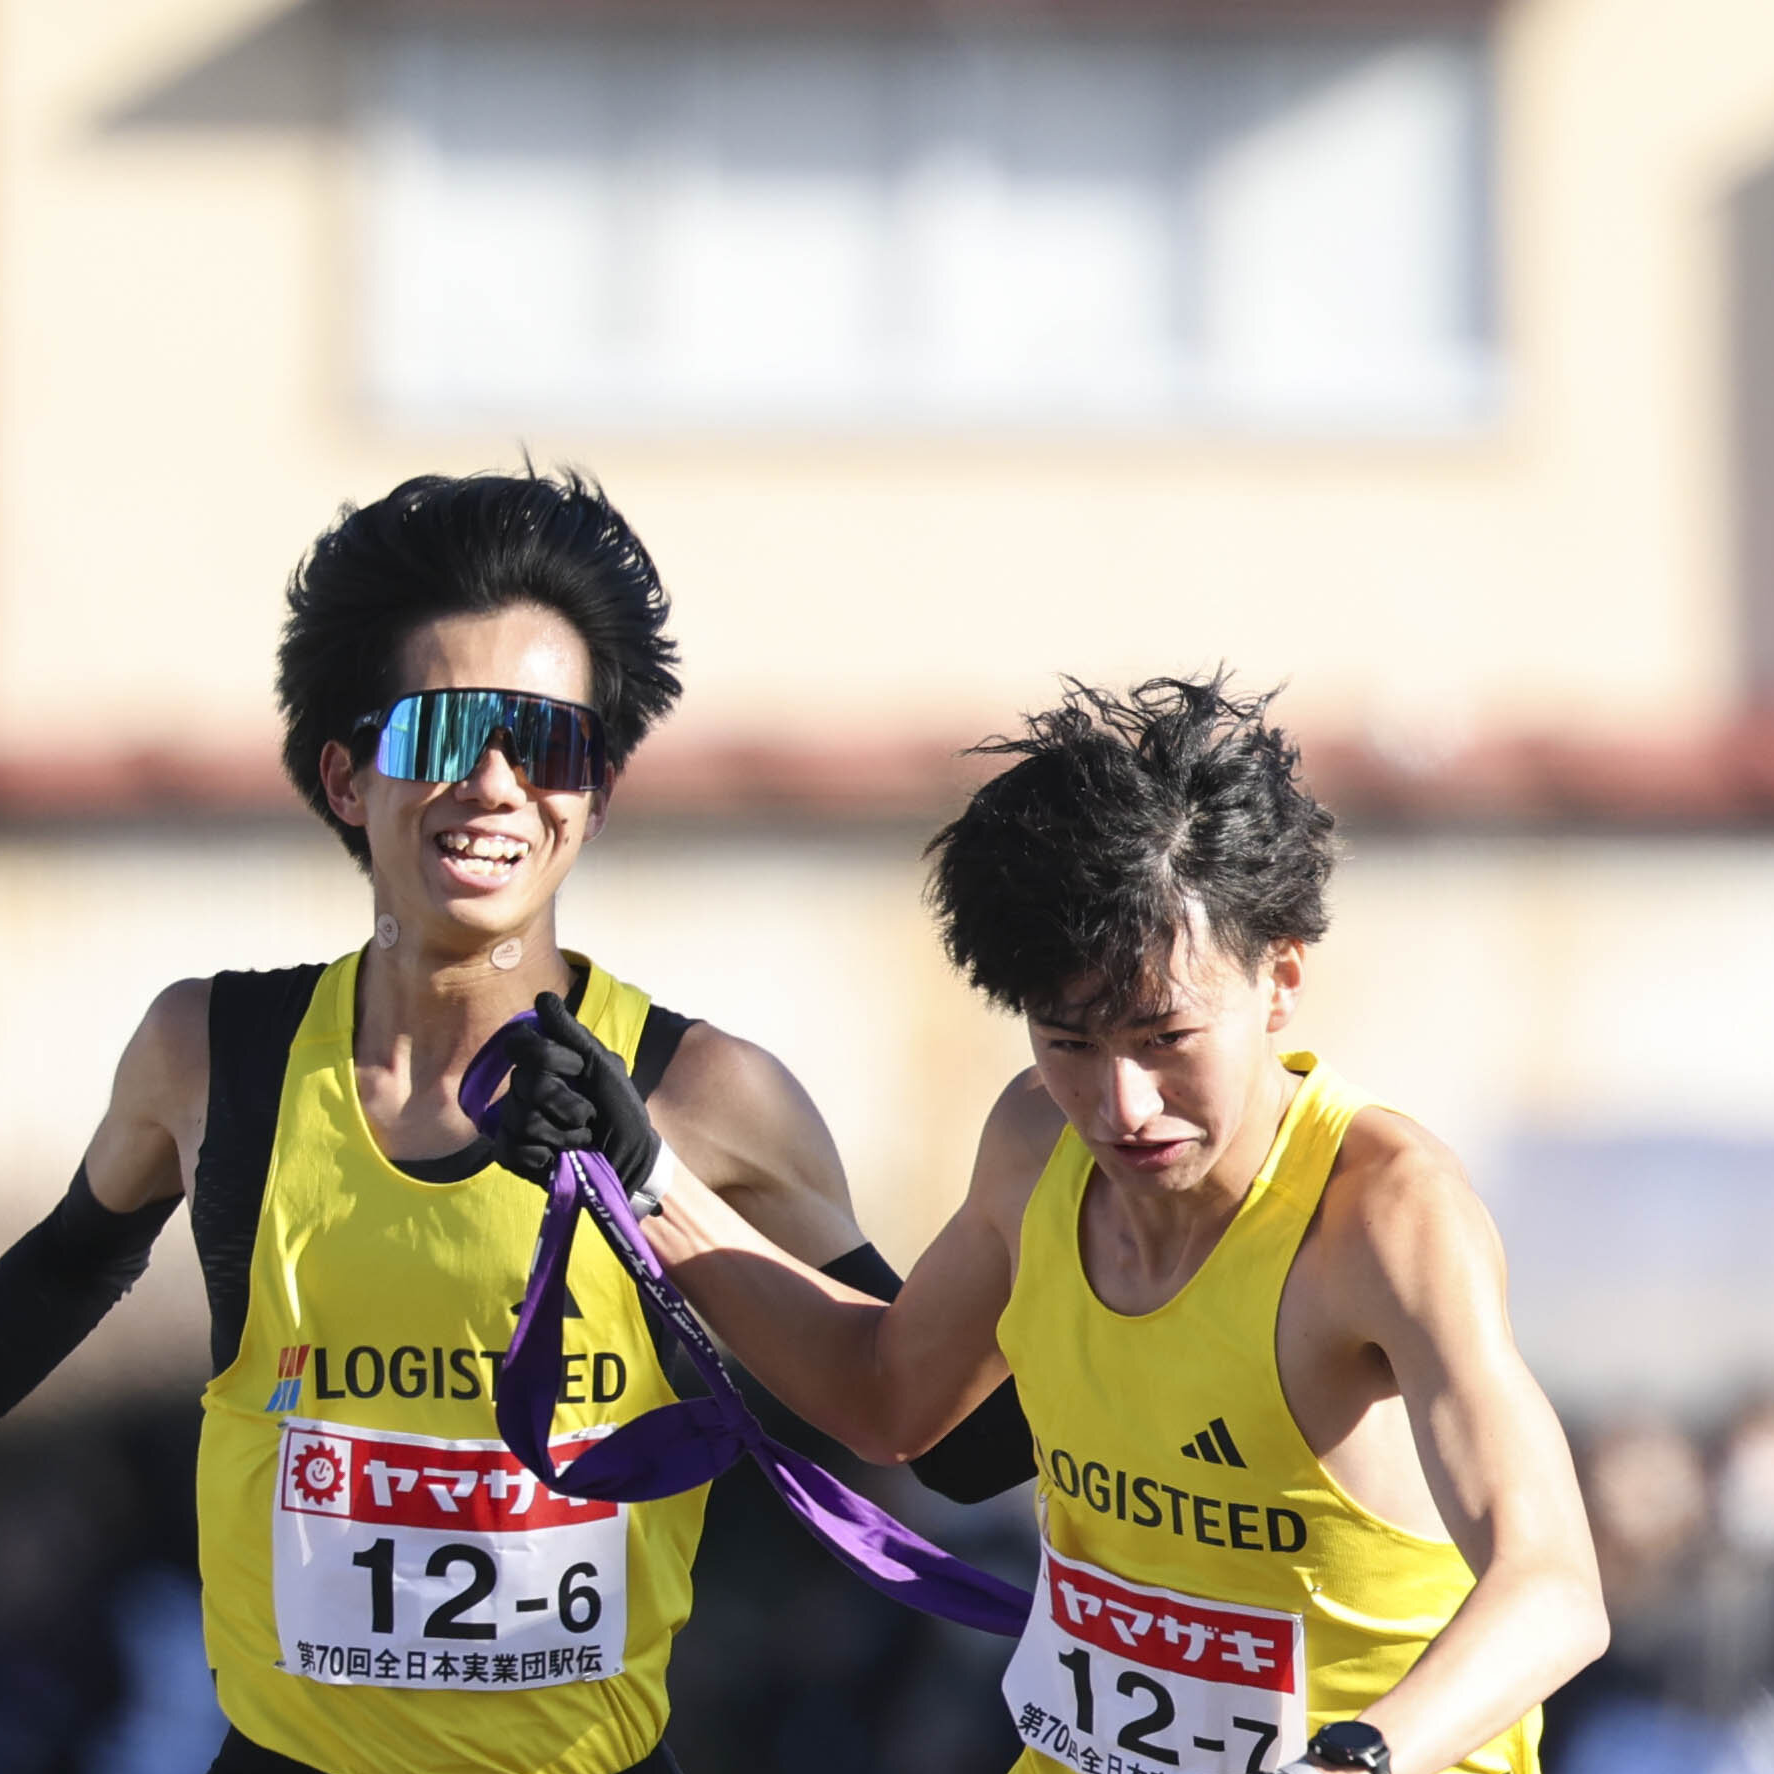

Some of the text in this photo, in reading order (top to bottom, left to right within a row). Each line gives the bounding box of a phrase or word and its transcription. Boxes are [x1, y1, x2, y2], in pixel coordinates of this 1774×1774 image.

[314, 1344, 627, 1405] LOGISTED
[352, 1537, 603, 1641] 12-6
[1058, 1579, 1276, 1673] ヤマザキ
[296, 1640, 604, 1684] 第70回全日本実業団駅伝
